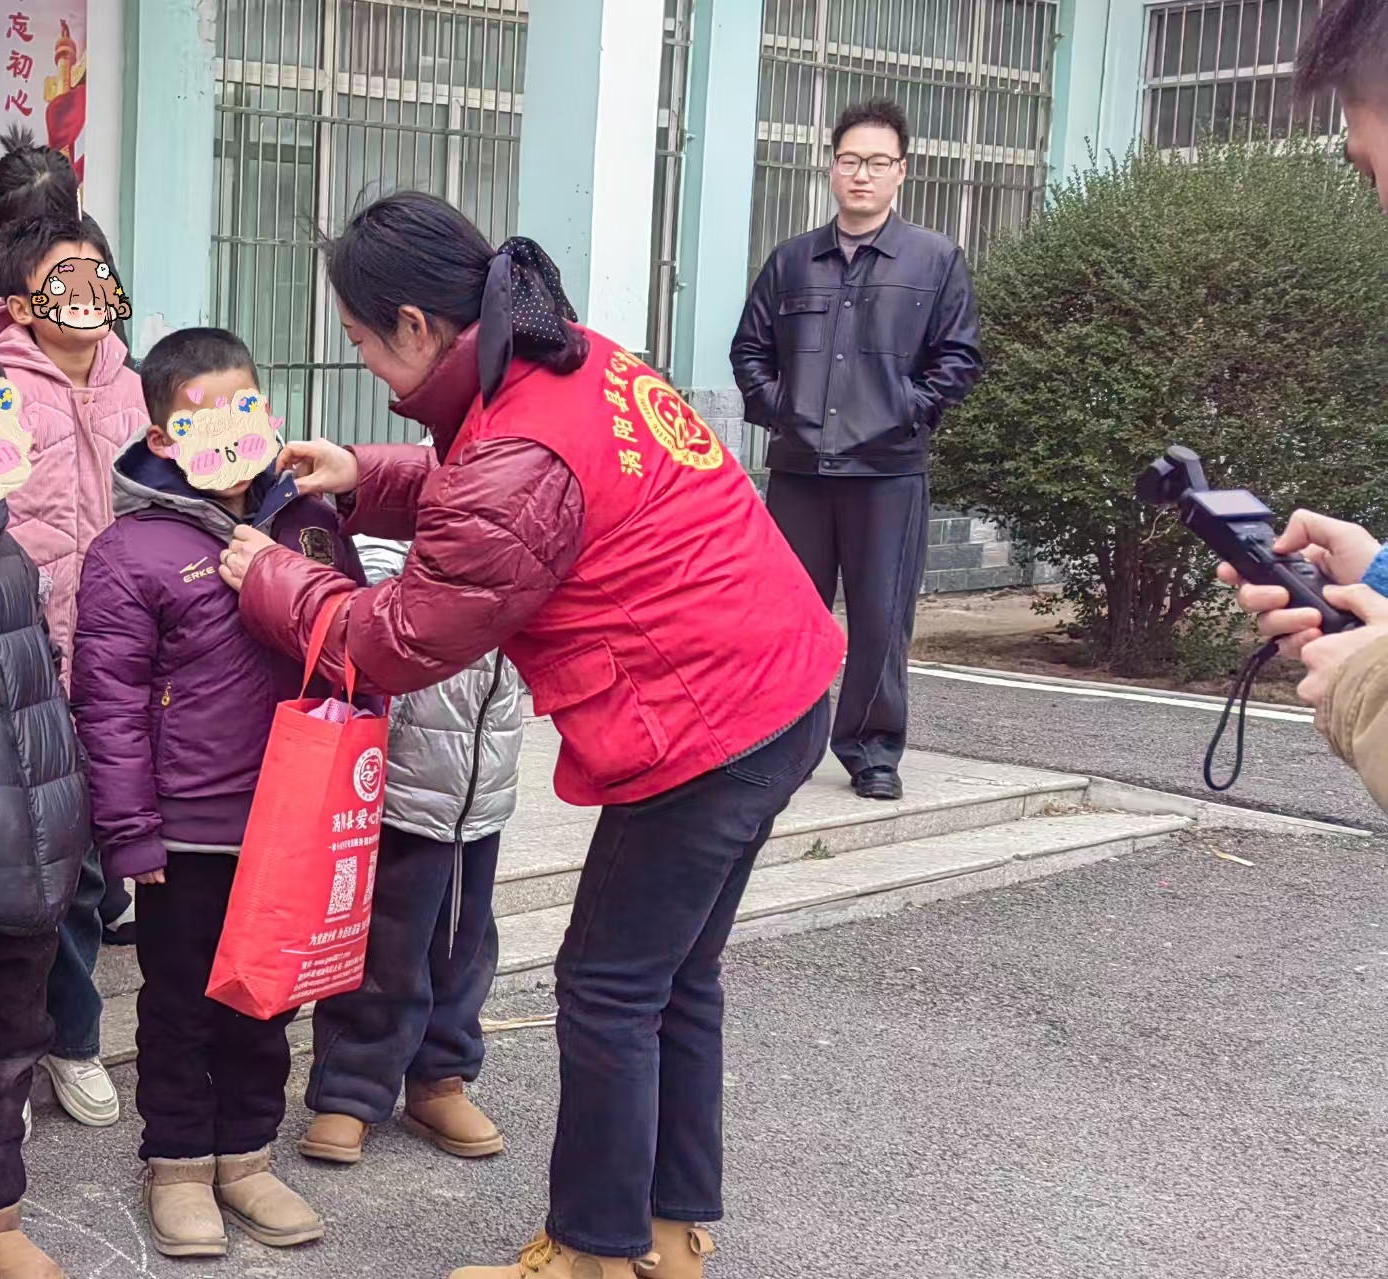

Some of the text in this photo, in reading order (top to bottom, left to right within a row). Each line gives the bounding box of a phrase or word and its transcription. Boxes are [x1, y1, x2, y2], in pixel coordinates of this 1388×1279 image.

[5, 0, 34, 117] 忘初心
[183, 566, 215, 583] ERKE
